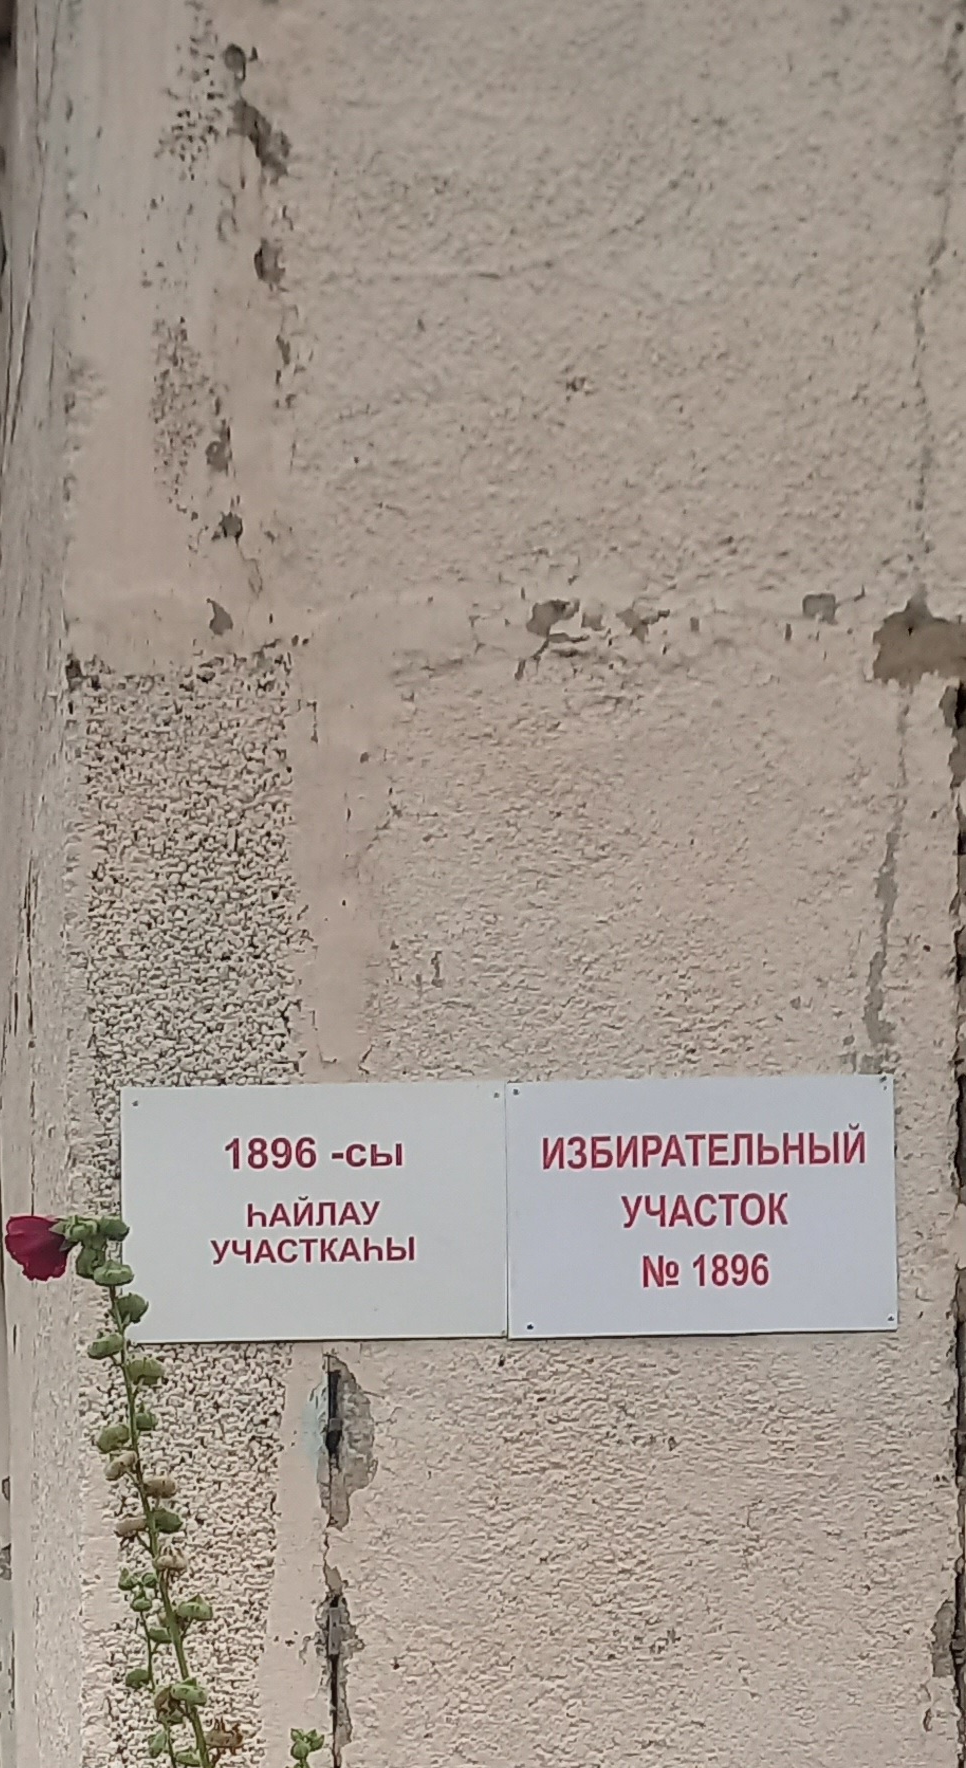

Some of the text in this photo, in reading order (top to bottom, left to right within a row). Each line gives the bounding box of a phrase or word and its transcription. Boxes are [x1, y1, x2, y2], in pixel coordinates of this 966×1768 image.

[224, 1137, 403, 1170] 1896 -сы
[542, 1122, 866, 1170] ИЗБИРАТЕЛЬНЫЙ
[621, 1192, 789, 1228] УЧАСТОК
[642, 1253, 770, 1288] № 1896
